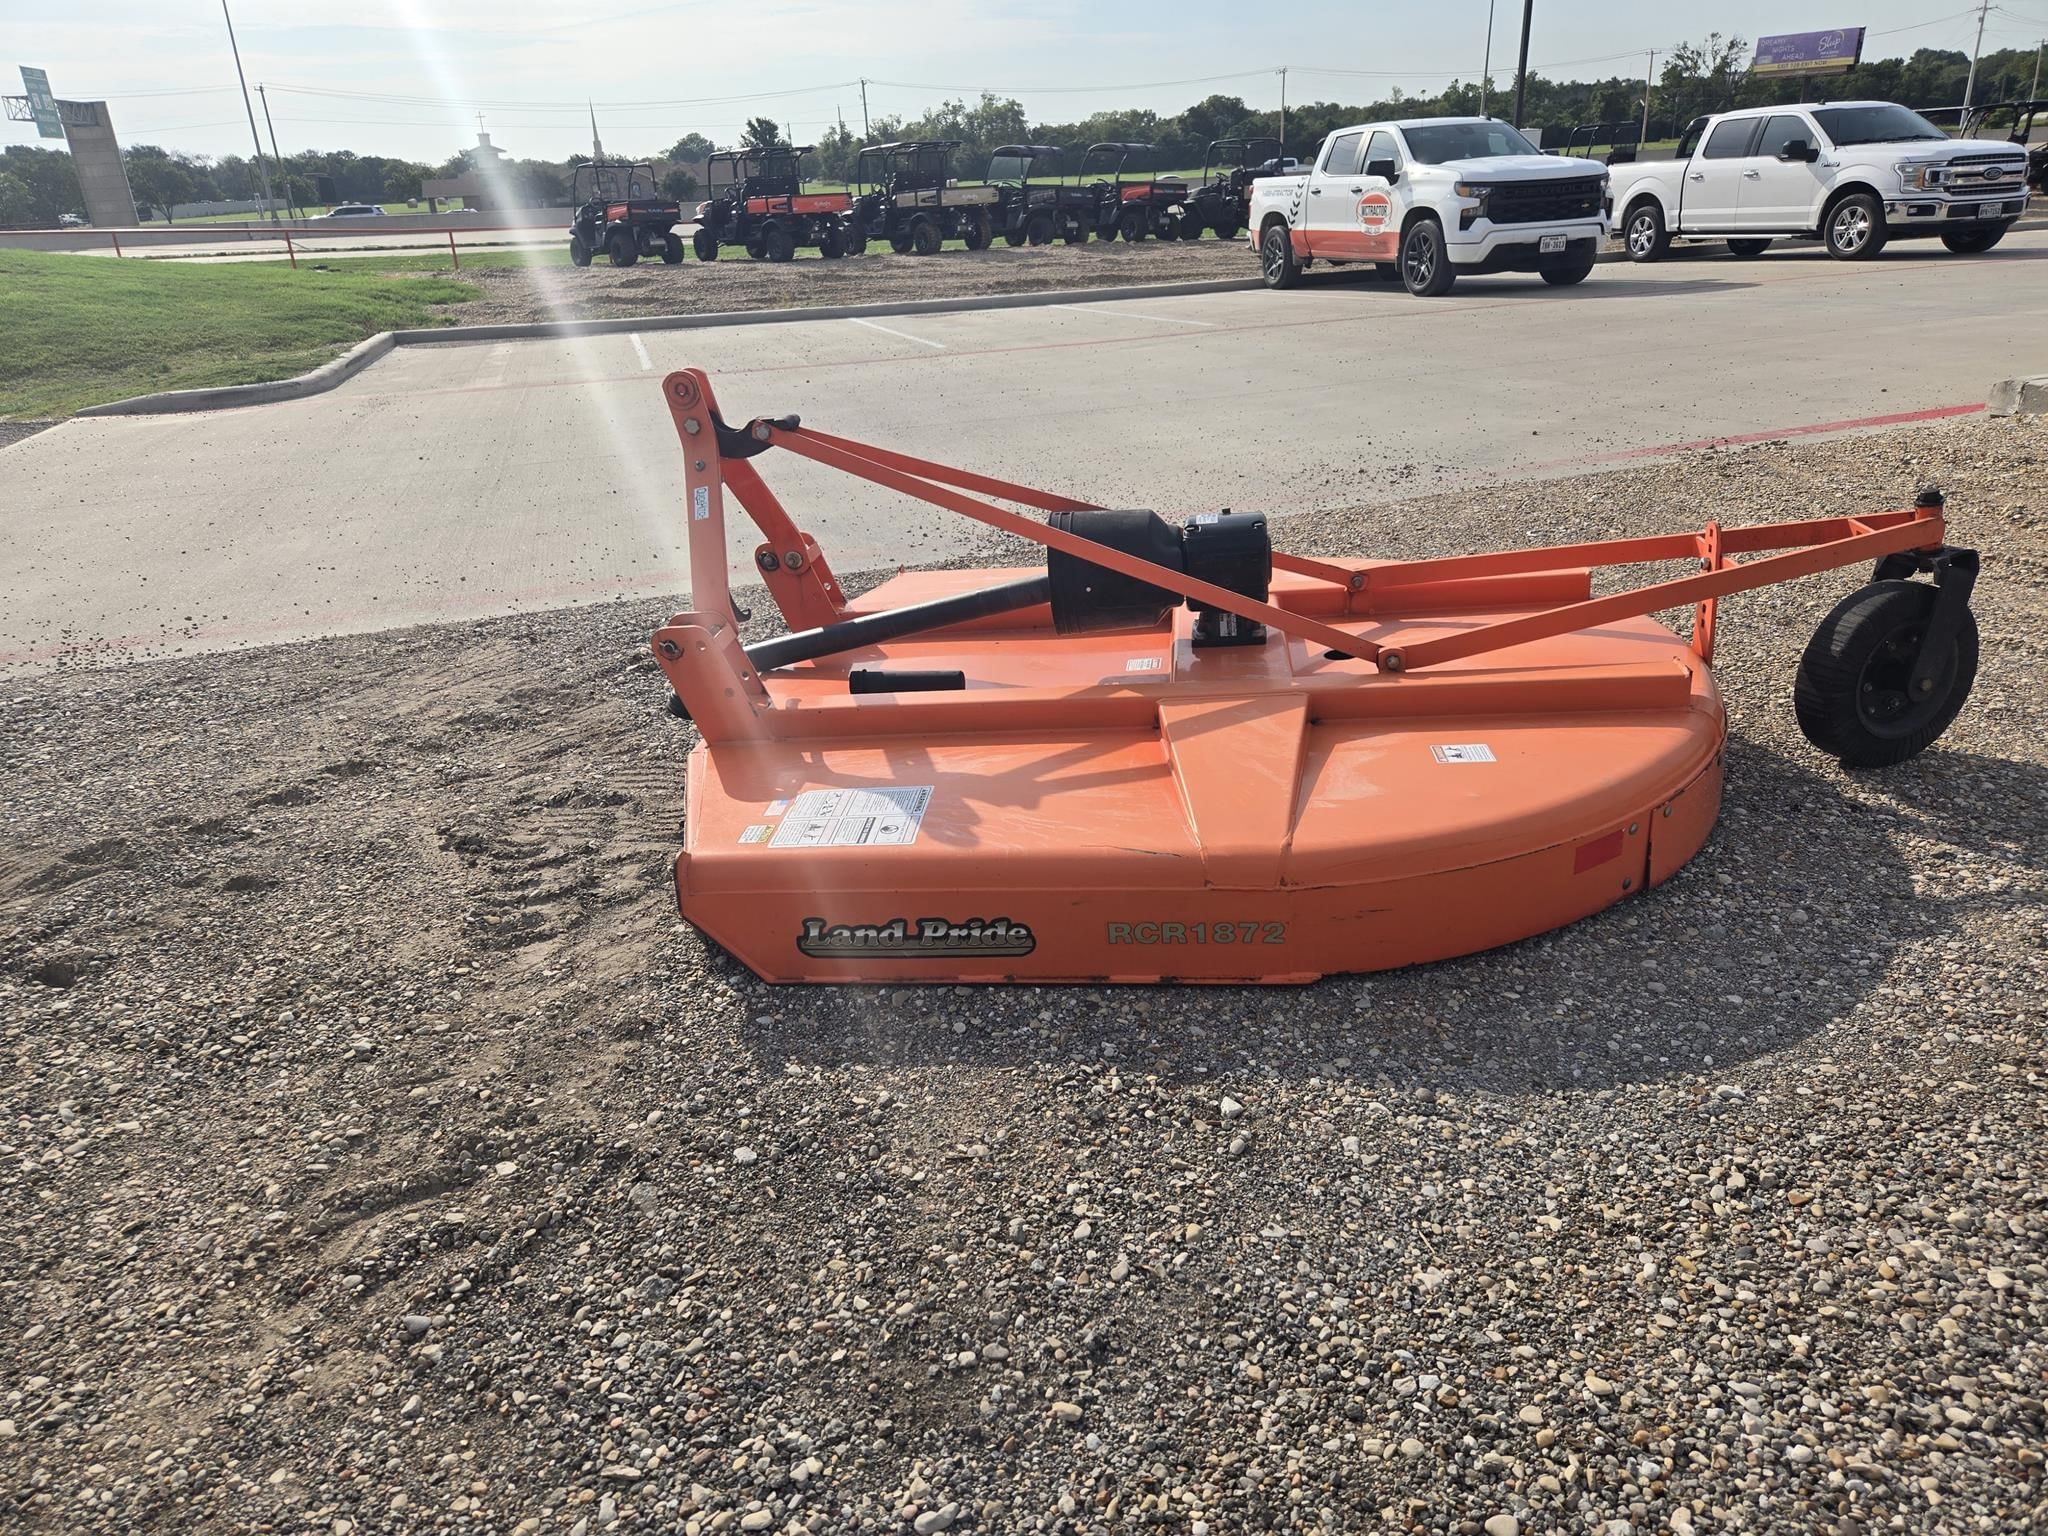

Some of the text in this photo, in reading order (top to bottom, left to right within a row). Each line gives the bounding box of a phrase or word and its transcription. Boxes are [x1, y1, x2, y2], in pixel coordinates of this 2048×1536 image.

[1782, 52, 1805, 60] AHEAD
[803, 920, 1028, 947] Land Pride
[1107, 921, 1286, 945] RCR1872
